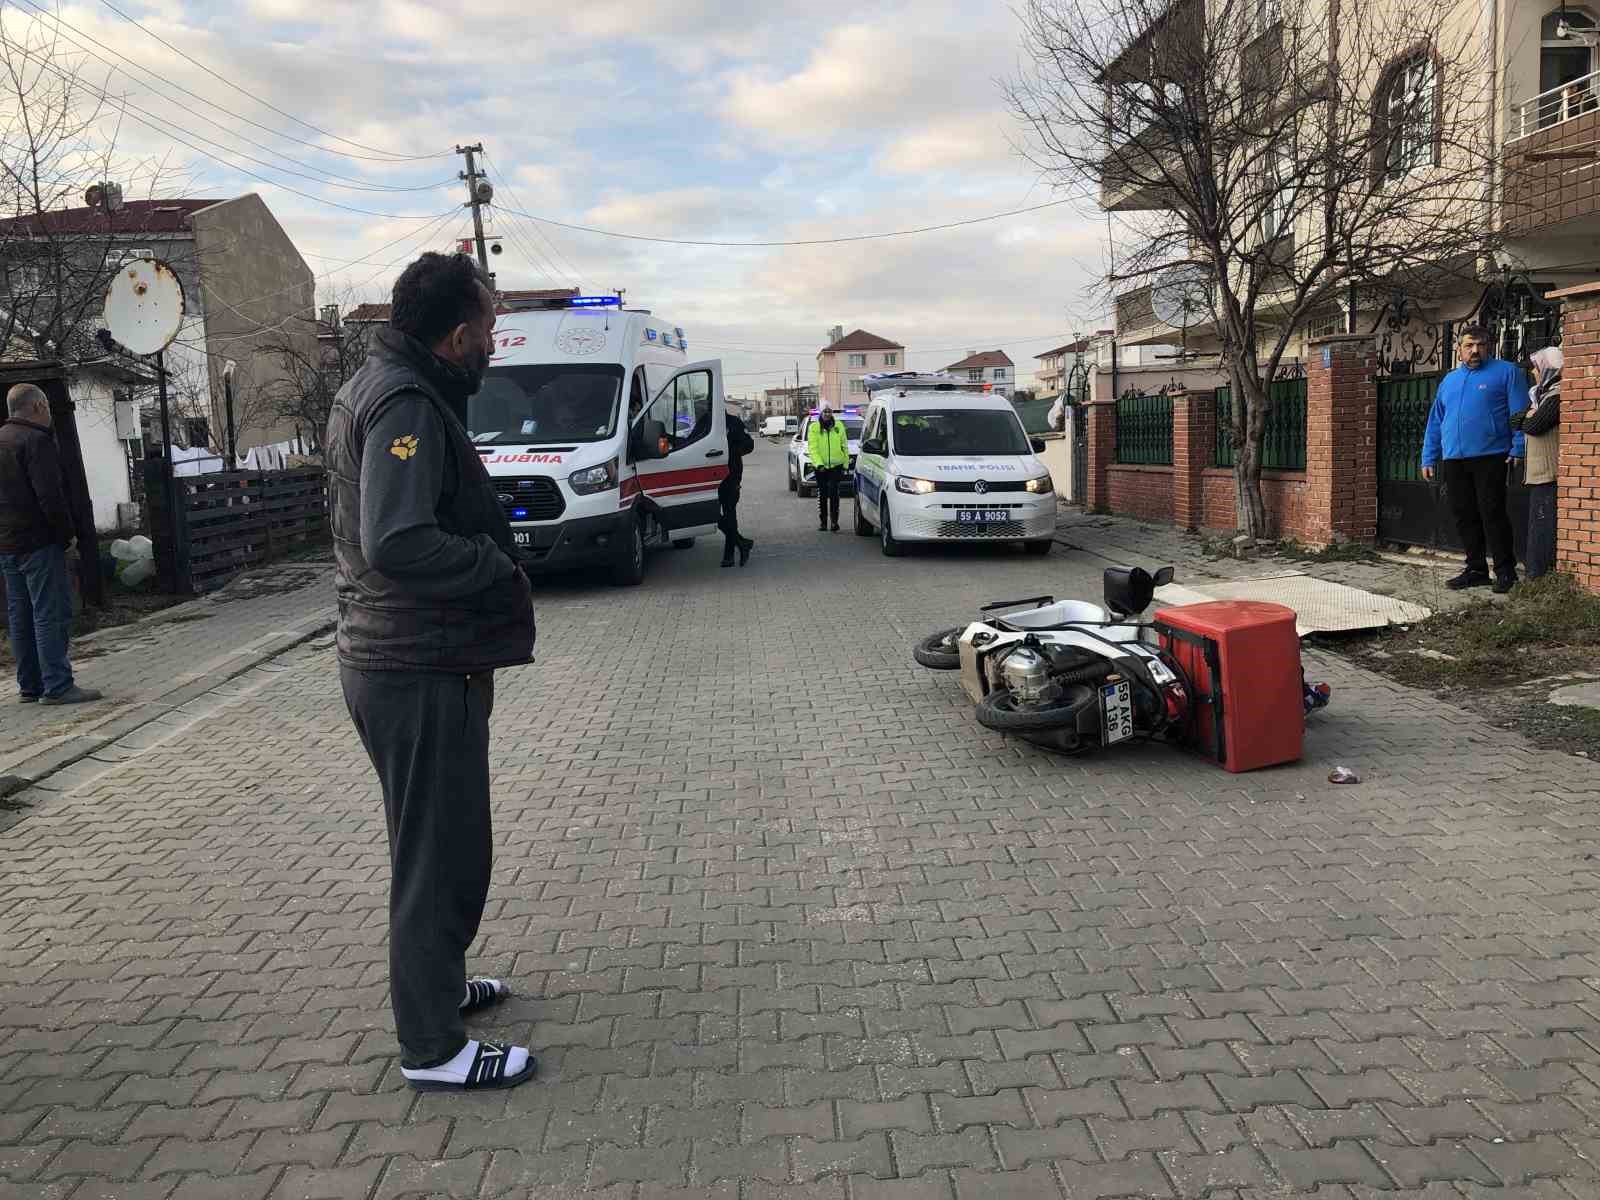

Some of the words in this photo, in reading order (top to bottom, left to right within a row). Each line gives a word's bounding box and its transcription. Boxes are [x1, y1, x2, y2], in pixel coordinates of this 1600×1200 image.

[498, 336, 527, 348] 12
[960, 511, 971, 521] 59
[974, 511, 981, 521] A
[984, 511, 1007, 521] 9052
[1118, 683, 1129, 702] 59
[1119, 706, 1132, 736] AKG
